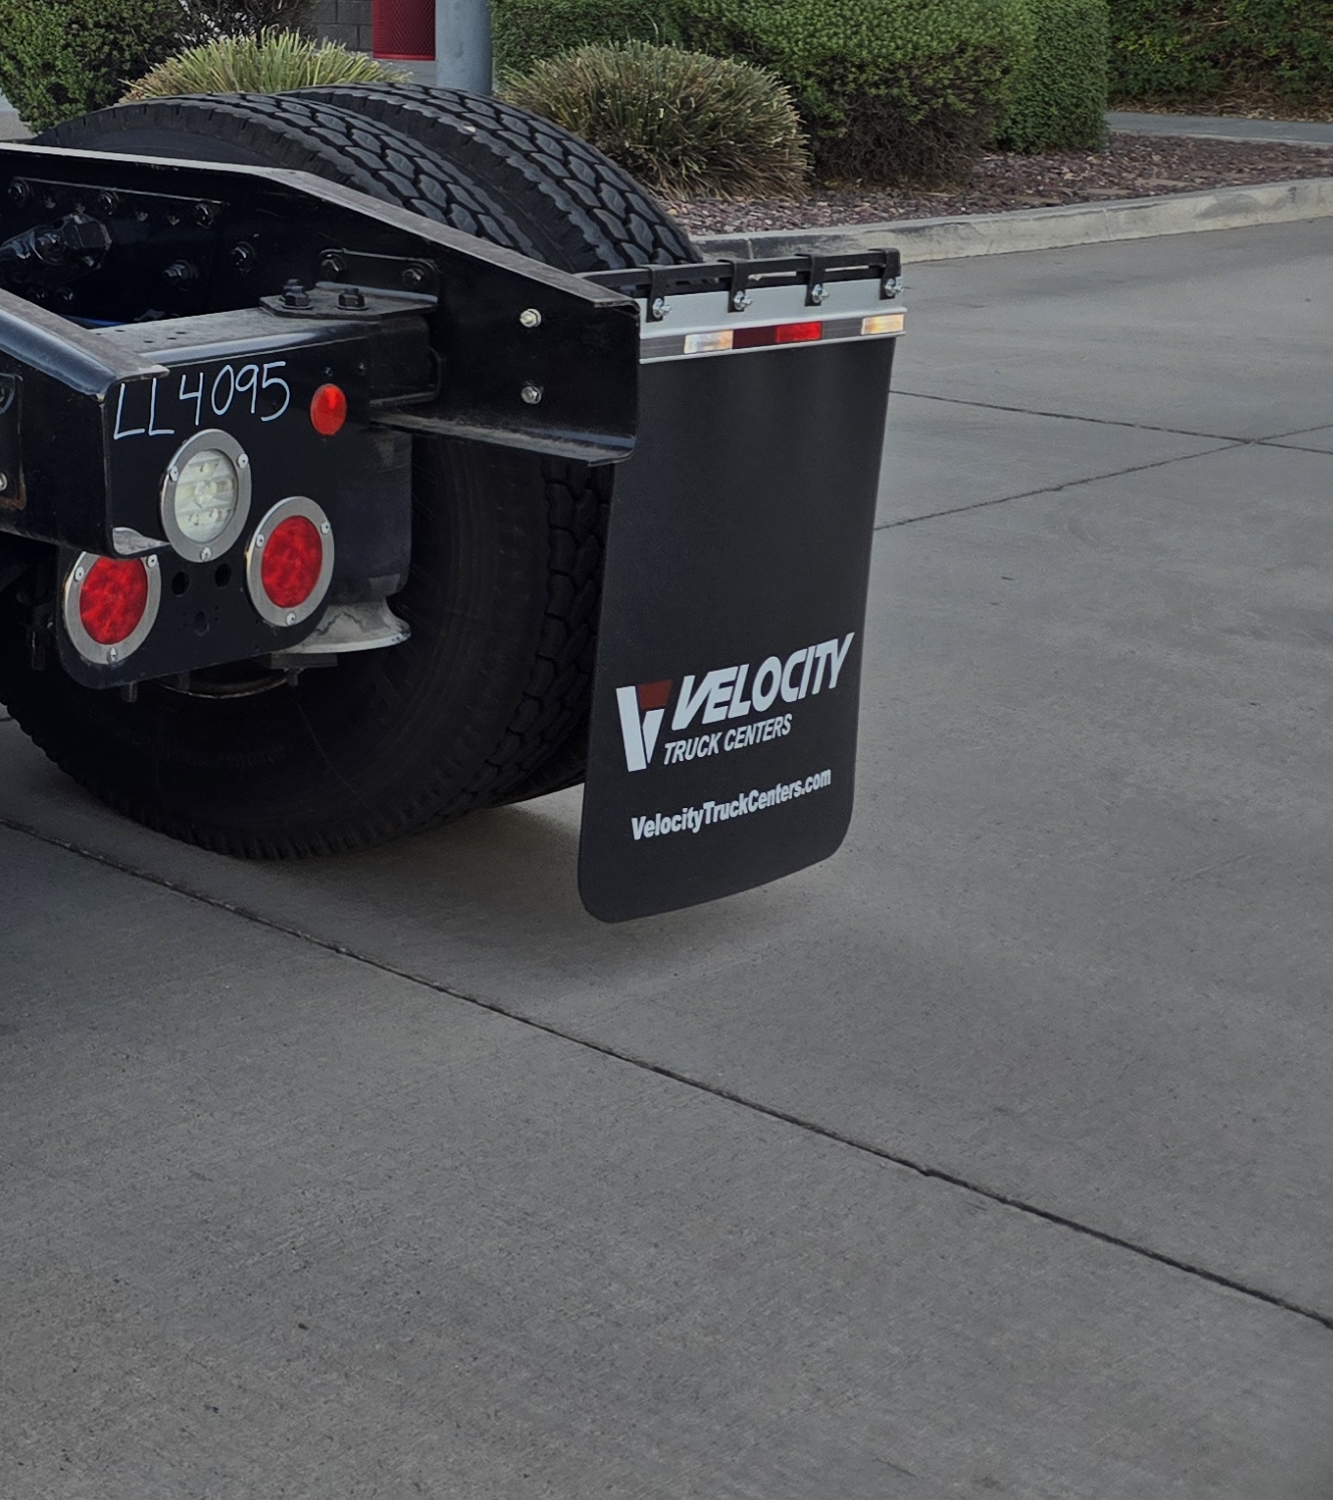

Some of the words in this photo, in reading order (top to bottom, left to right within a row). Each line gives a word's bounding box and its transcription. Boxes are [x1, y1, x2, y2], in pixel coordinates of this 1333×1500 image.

[671, 631, 855, 731] VELOCITY
[663, 731, 723, 766] TRUCK
[723, 713, 793, 752] CENTERS
[631, 768, 832, 841] VelocityTruckCenters.com
